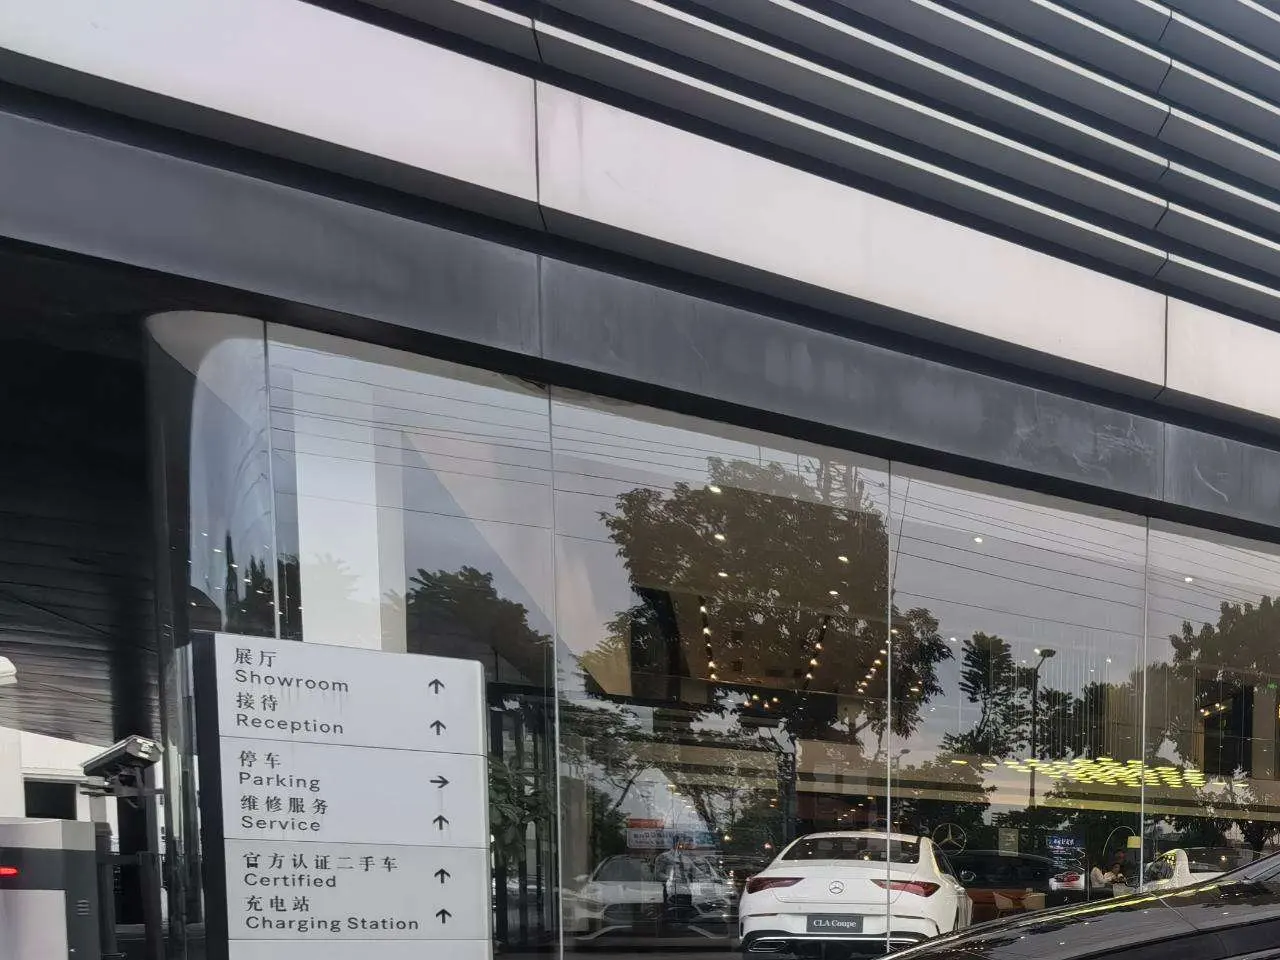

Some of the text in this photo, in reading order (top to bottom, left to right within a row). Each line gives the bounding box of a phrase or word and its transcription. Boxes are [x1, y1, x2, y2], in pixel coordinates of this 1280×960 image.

[233, 648, 277, 668] 展厅
[235, 669, 349, 693] Showroom
[236, 692, 278, 712] 接待
[236, 714, 344, 734] Reception
[239, 750, 281, 769] 停车
[239, 772, 321, 792] Parking
[240, 795, 328, 815] 维修服务
[241, 816, 321, 831] Service
[243, 853, 399, 872] 官方认证二手车
[244, 873, 337, 888] Certified
[246, 895, 310, 912] 充电站
[246, 916, 419, 932] Charging Station
[813, 919, 831, 927] CLA
